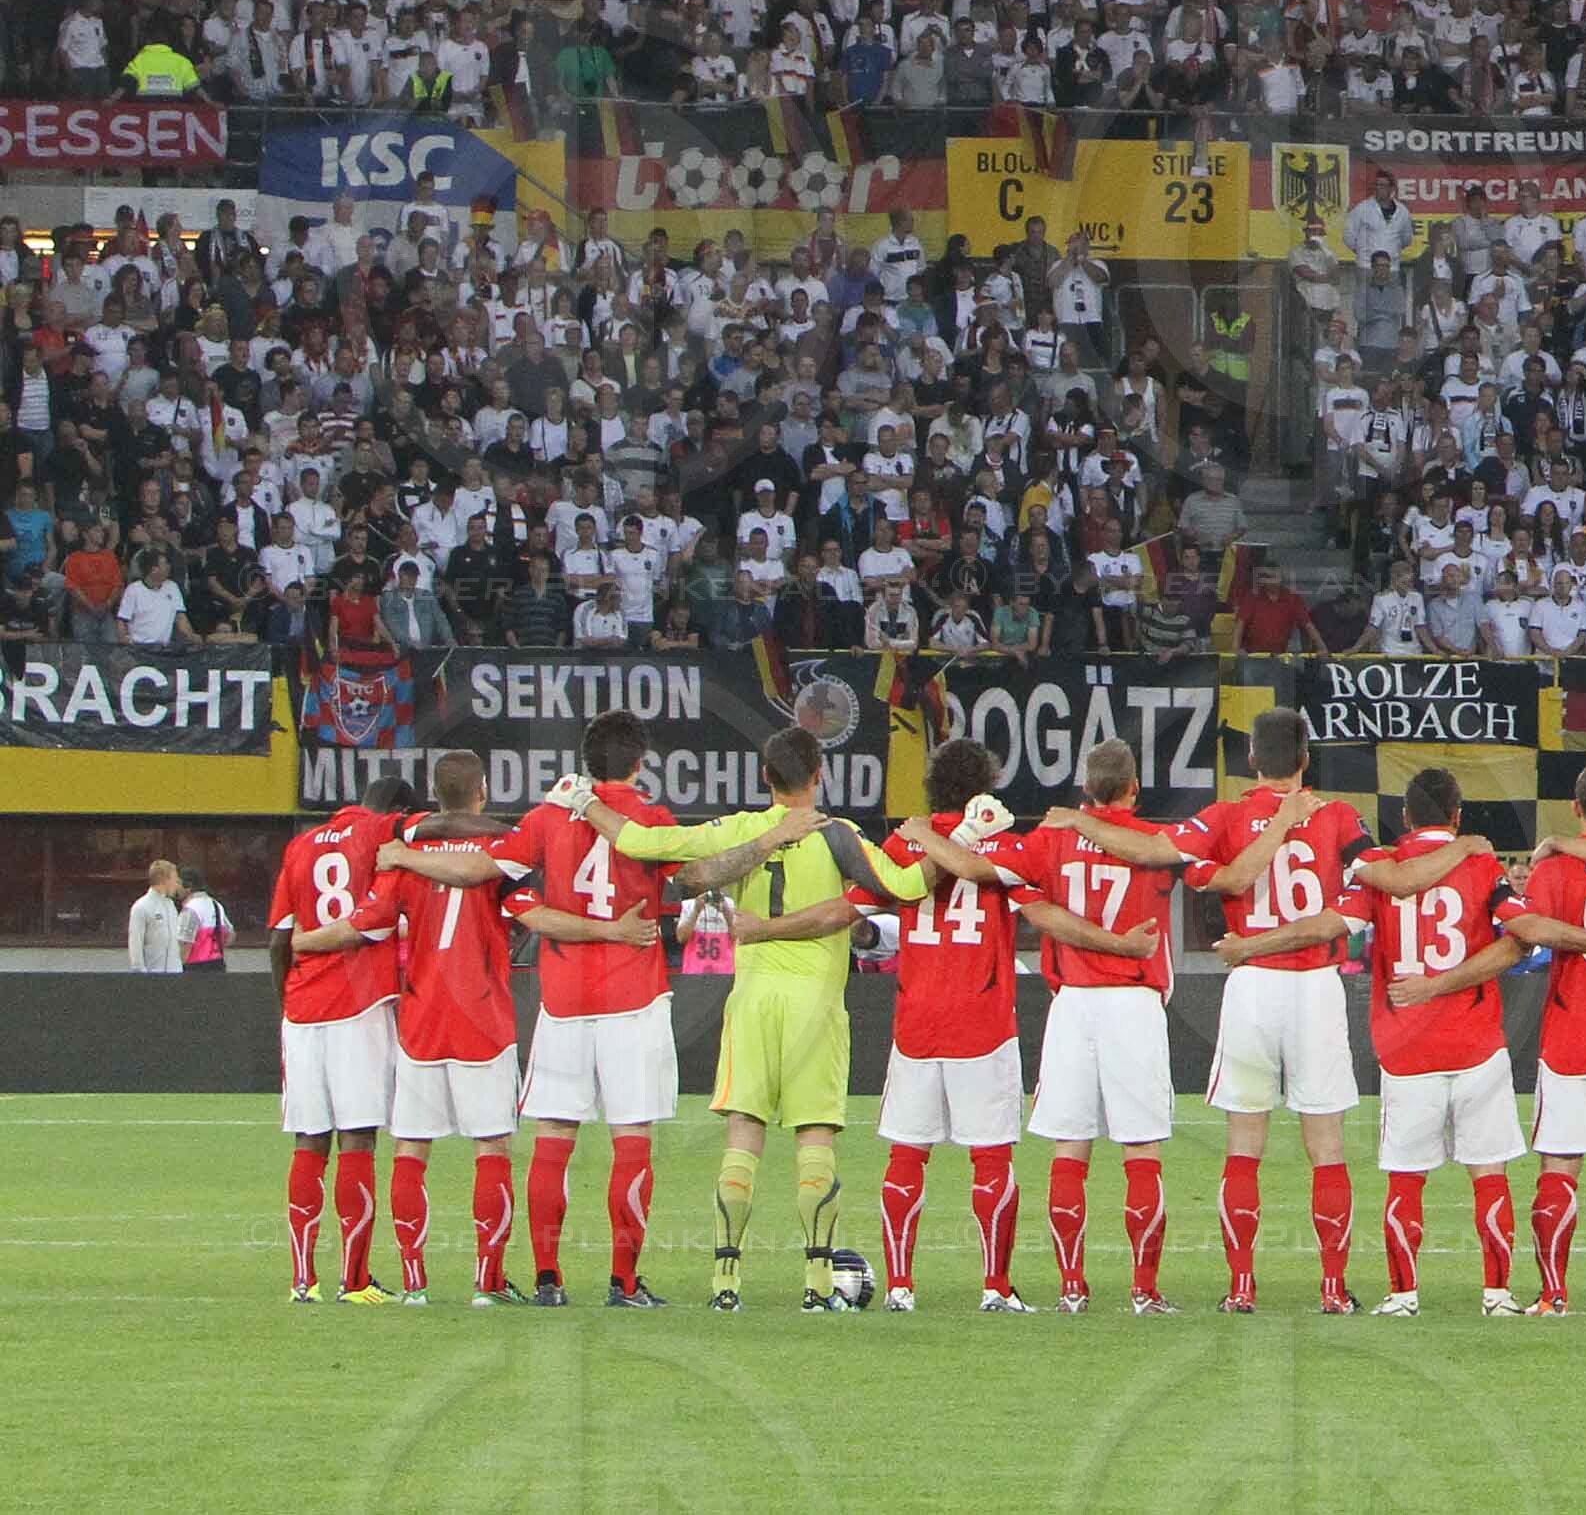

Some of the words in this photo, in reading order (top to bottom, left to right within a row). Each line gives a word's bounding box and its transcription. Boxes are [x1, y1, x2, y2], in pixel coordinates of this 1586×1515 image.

[320, 131, 456, 191] KSC
[999, 178, 1024, 222] C
[1165, 180, 1215, 224] 23
[1079, 222, 1111, 242] WC
[0, 662, 271, 731] RACHT
[471, 664, 700, 721] SEKTION
[1328, 661, 1480, 700] BOLZE
[313, 851, 354, 926] 8
[573, 834, 613, 919] 4
[764, 861, 785, 918] 1
[1061, 861, 1130, 933] 17
[1245, 839, 1324, 930] 16
[907, 878, 985, 945] 14
[1391, 885, 1467, 975] 13
[696, 938, 721, 961] 36
